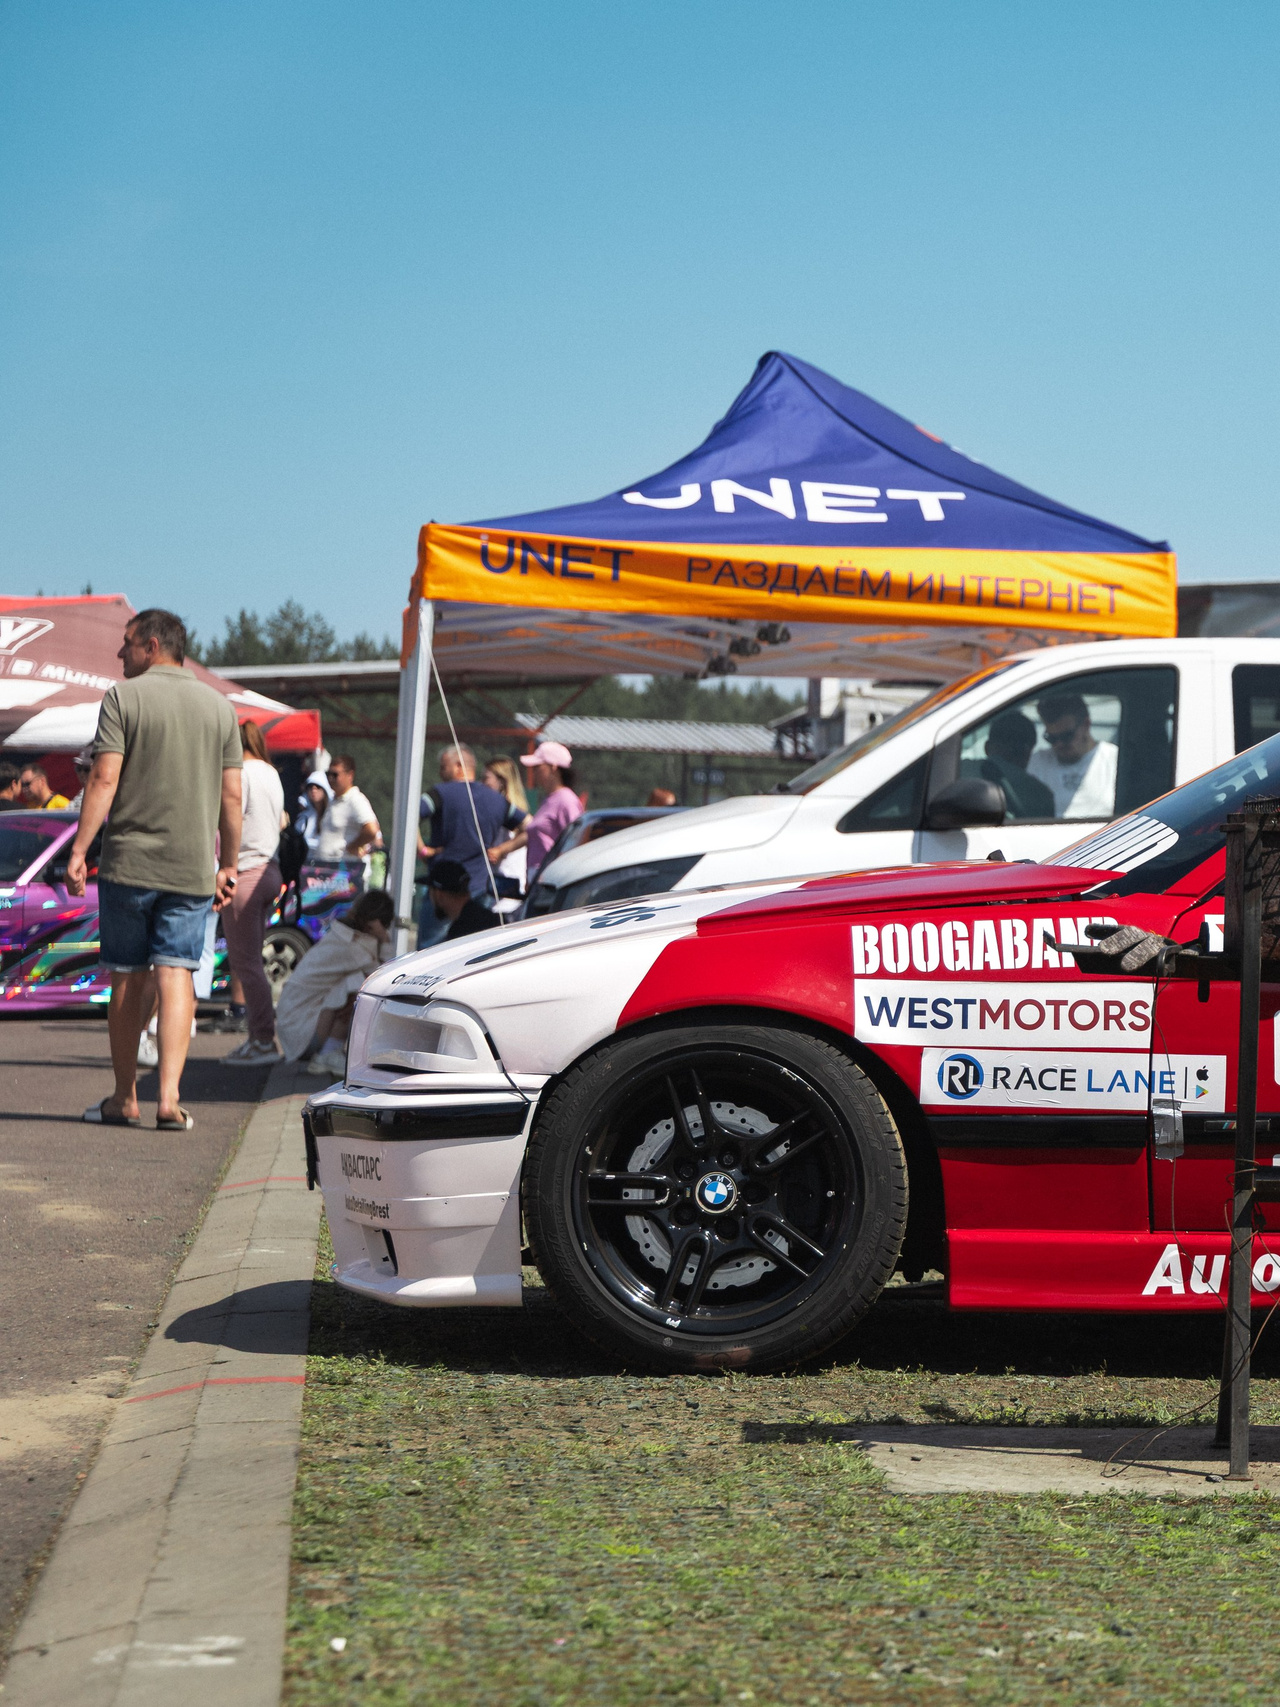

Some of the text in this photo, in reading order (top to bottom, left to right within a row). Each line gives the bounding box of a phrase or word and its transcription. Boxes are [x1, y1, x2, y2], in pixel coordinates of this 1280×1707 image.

[622, 478, 966, 523] UNET
[480, 535, 635, 582] UNET
[686, 557, 1124, 614] РАЗДАЁМ ИНТЕРНЕТ
[864, 996, 1151, 1031] WESTMOTORS
[993, 1066, 1077, 1092] RACE
[1087, 1068, 1176, 1094] LANE
[703, 1175, 735, 1191] BMW
